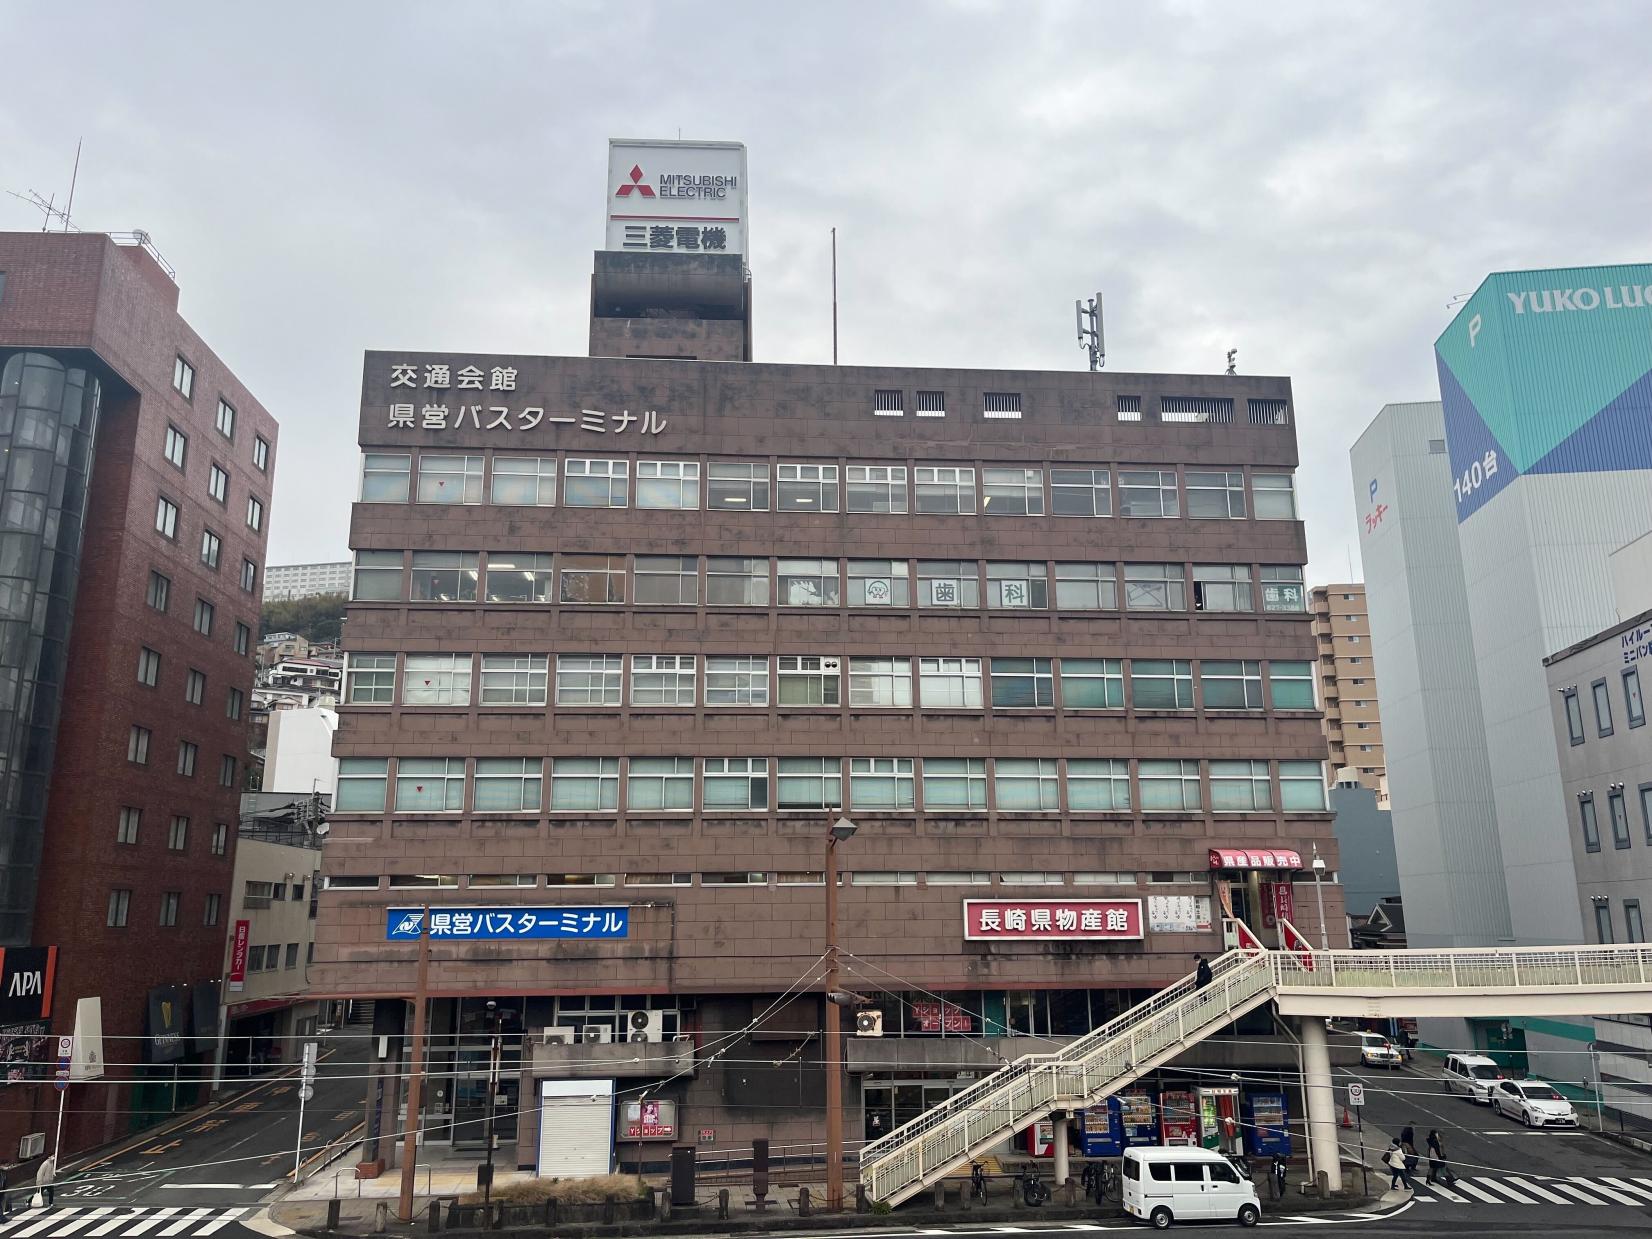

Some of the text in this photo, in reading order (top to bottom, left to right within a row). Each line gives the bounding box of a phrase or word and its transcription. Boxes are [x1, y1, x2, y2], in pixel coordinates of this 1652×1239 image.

[659, 174, 737, 187] MITSUBISHI
[659, 186, 727, 199] ELECTRIC
[622, 225, 727, 250] 三菱電機
[1506, 287, 1601, 314] YUKO
[1468, 313, 1482, 348] P
[390, 363, 519, 391] 交通会館
[387, 403, 667, 435] 県営バスターミナル
[1453, 449, 1498, 503] 140台
[1369, 478, 1378, 503] P
[1265, 588, 1299, 602] 歯科
[1621, 623, 1652, 648] ハイルー
[1223, 855, 1302, 867] 県産品販売中
[430, 912, 623, 934] 県営バスターミナル
[979, 908, 1129, 932] 長崎県物産館
[8, 970, 42, 997] APA
